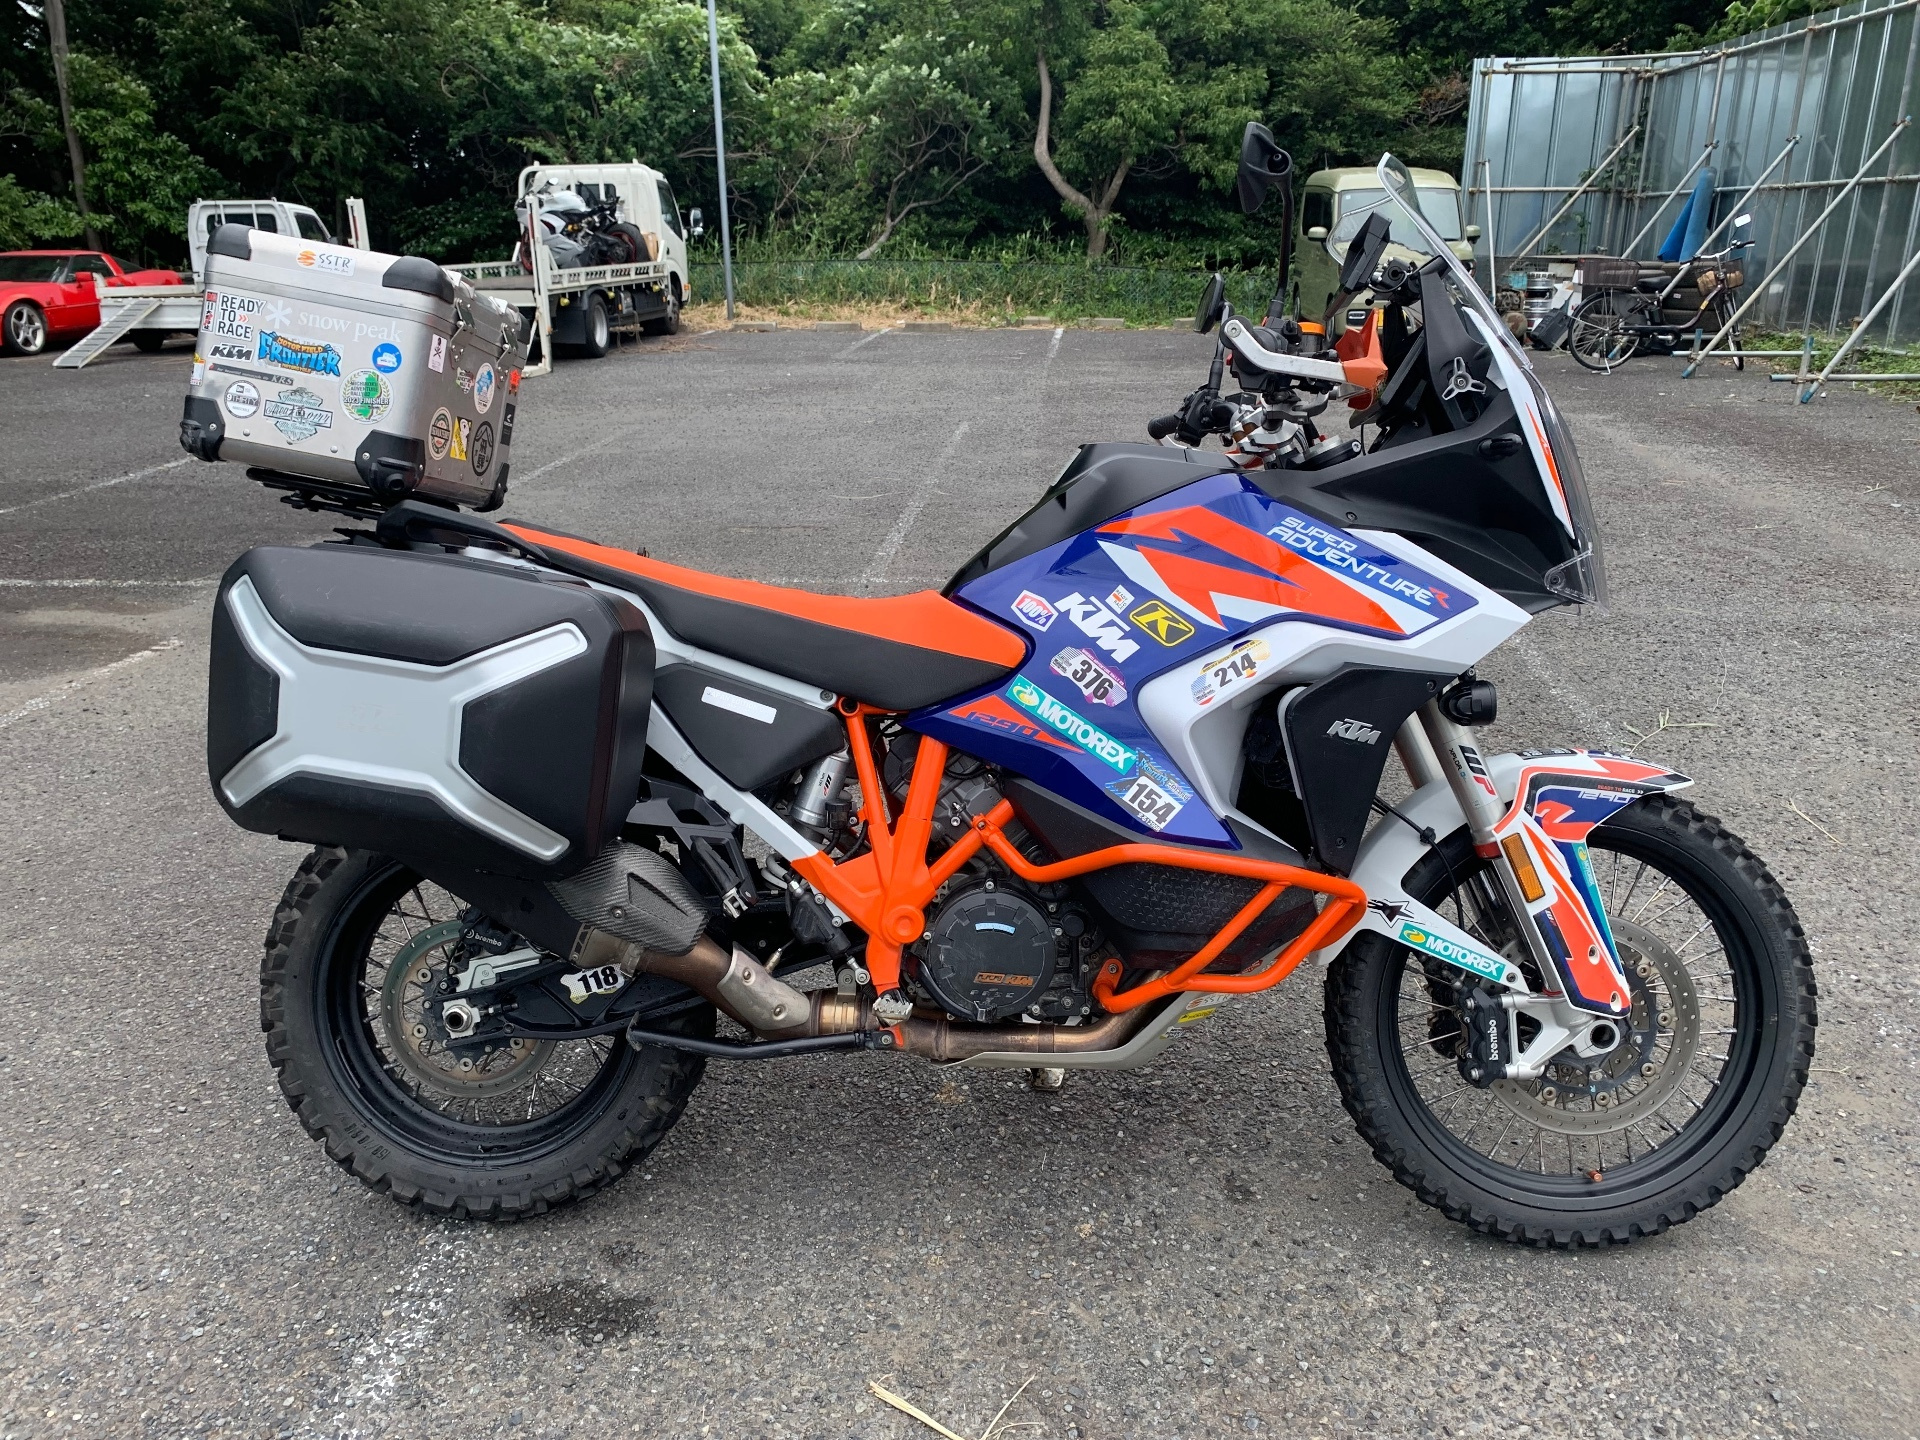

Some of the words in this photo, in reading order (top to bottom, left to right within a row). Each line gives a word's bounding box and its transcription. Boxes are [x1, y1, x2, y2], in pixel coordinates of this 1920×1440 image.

[319, 253, 350, 268] SSTR
[220, 308, 236, 323] TO
[221, 294, 265, 314] READY
[218, 321, 252, 339] RACE
[298, 309, 352, 331] snow
[353, 320, 403, 342] peak
[210, 343, 253, 360] KTM
[259, 330, 341, 377] FRONTIER
[277, 337, 299, 351] MOTOR
[300, 345, 323, 354] FIELD
[271, 373, 293, 385] KRS
[360, 397, 390, 405] FINISHER
[1281, 516, 1358, 553] SUPER
[1266, 526, 1434, 606] ADVENTURE
[1018, 597, 1053, 625] 100%
[1053, 592, 1140, 664] KTM
[1072, 660, 1114, 700] 376
[1214, 653, 1257, 687] 214
[1037, 695, 1134, 770] MOTOREX
[1326, 718, 1382, 745] KTM
[1449, 748, 1463, 771] XPLOR
[1129, 782, 1176, 825] 154
[1578, 791, 1632, 804] 1290
[474, 932, 502, 947] brembo
[1425, 936, 1499, 977] MOTOREX
[577, 965, 619, 993] 118
[1487, 1019, 1499, 1060] brembo
